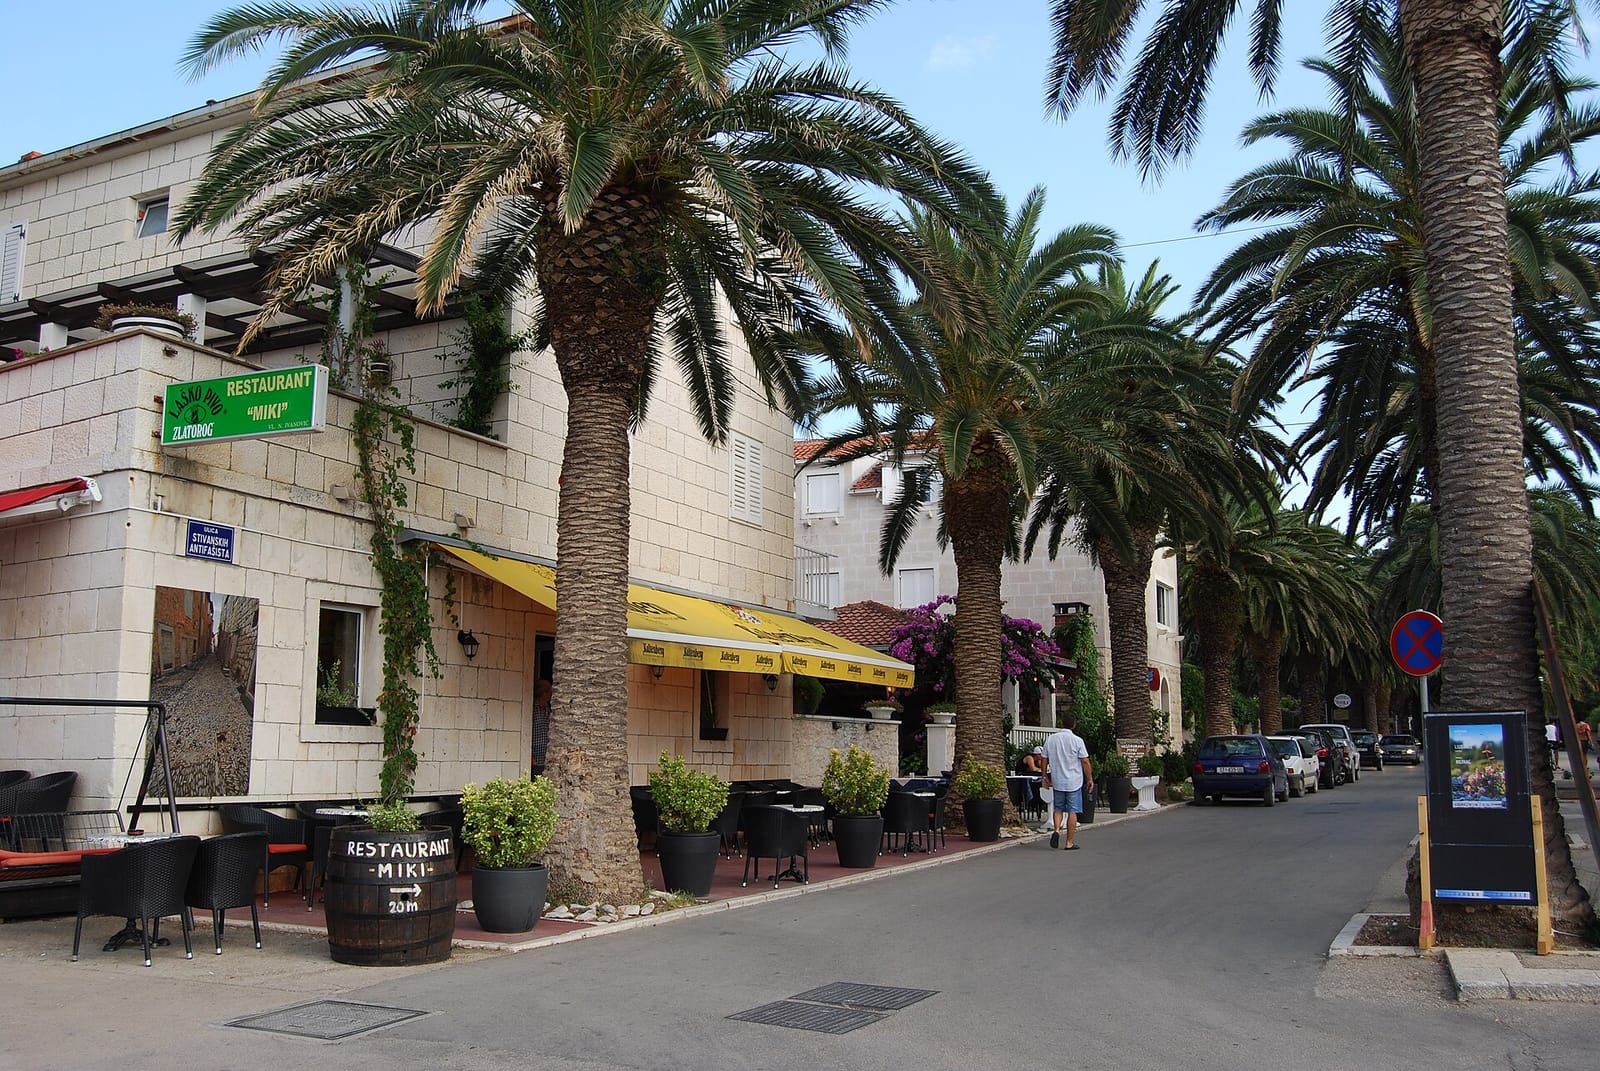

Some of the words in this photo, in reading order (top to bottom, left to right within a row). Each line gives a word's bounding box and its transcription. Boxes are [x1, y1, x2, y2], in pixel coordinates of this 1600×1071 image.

[227, 371, 313, 397] RESTAURANT
[168, 384, 202, 419] LAŠKO
[203, 387, 224, 416] PIVO
[172, 422, 215, 441] ZLATOROG
[203, 526, 219, 534] ULICA
[192, 532, 229, 548] STIVANSKIH
[189, 543, 230, 559] ANTIFAŠISTA
[347, 838, 449, 858] RESTAURANT
